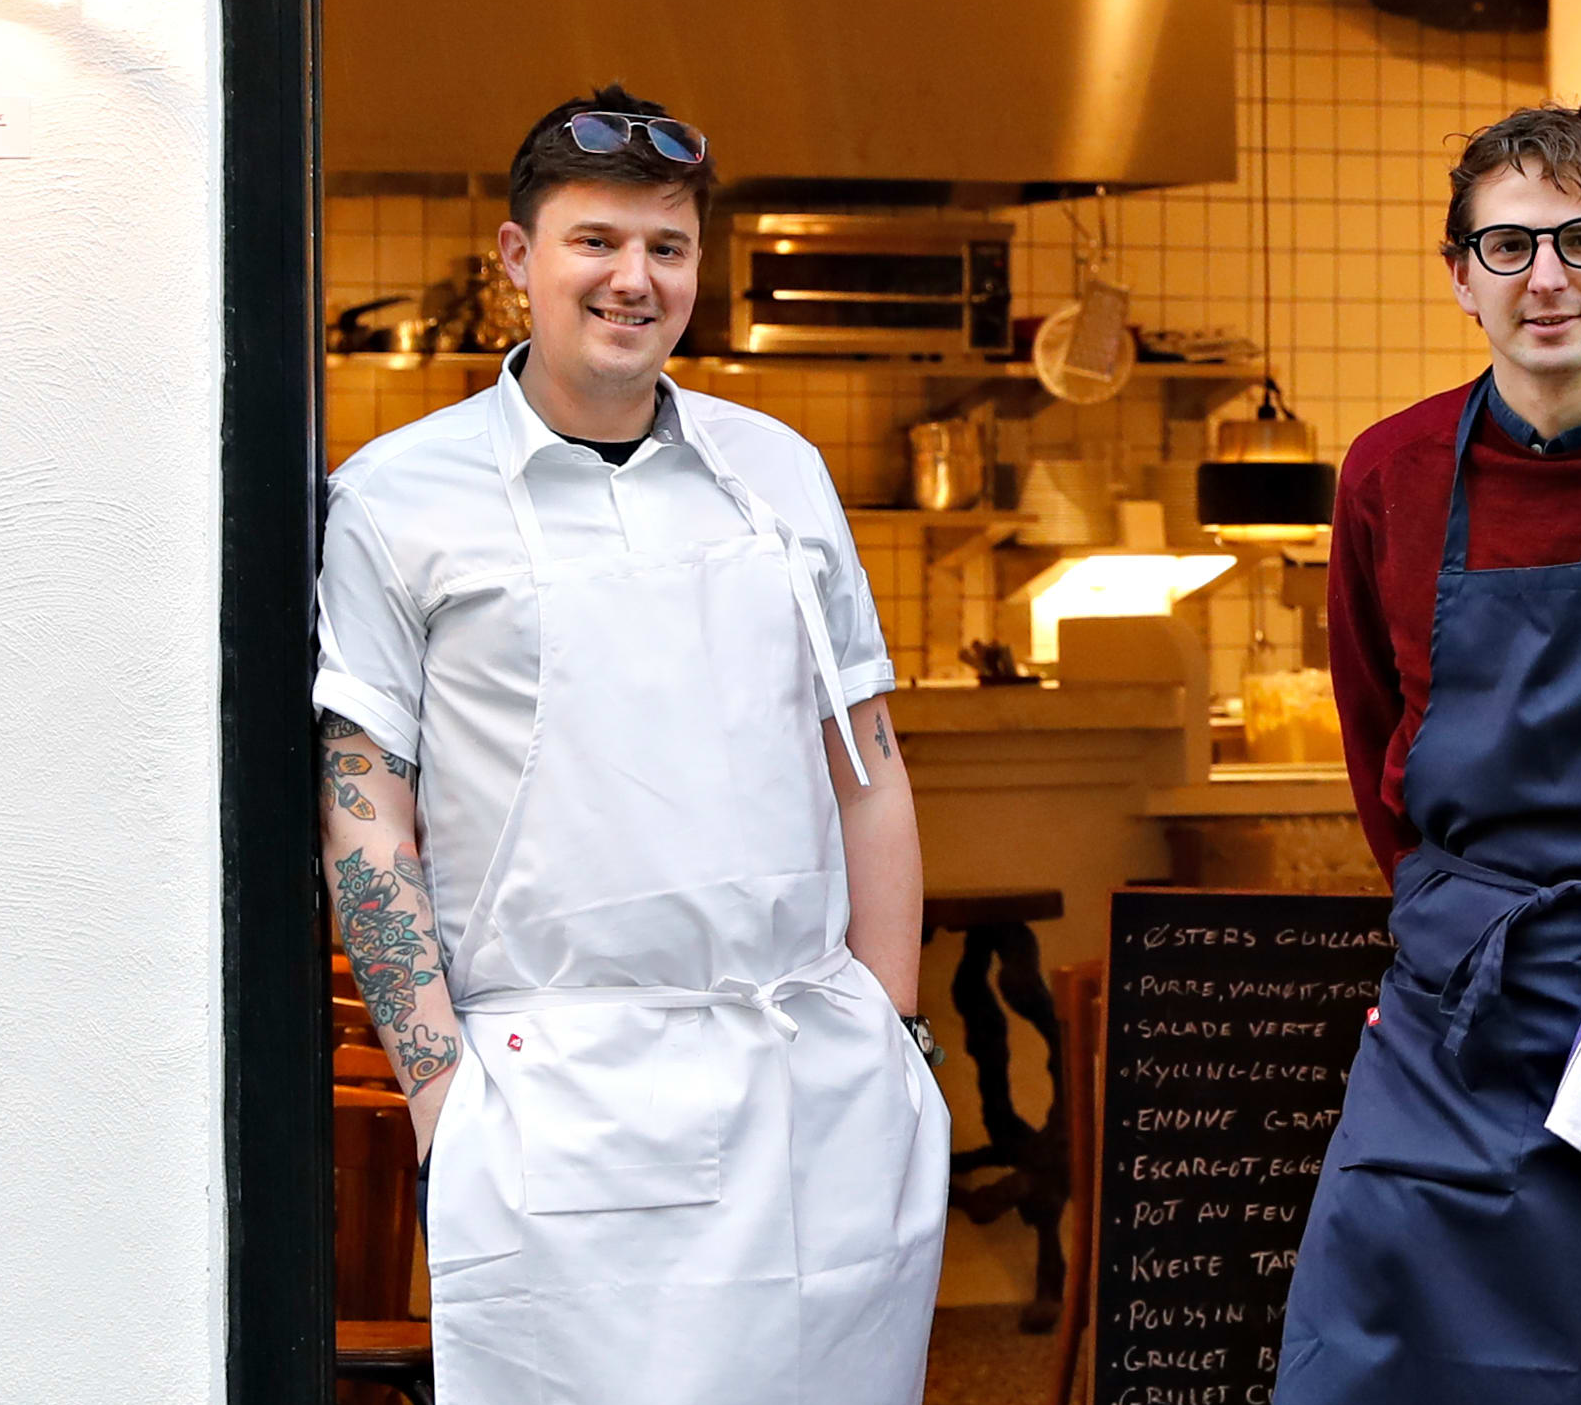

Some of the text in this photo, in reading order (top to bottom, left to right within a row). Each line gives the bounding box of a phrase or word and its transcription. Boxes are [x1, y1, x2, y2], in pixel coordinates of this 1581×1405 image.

[1137, 1019, 1327, 1039] SALADE VERTE
[1137, 1107, 1237, 1132] ENDIVE
[1132, 1199, 1183, 1230] POT
[1130, 1247, 1222, 1282] KVEITE
[1129, 1299, 1244, 1331] POUSSIN
[1123, 1345, 1227, 1372] GRILLET
